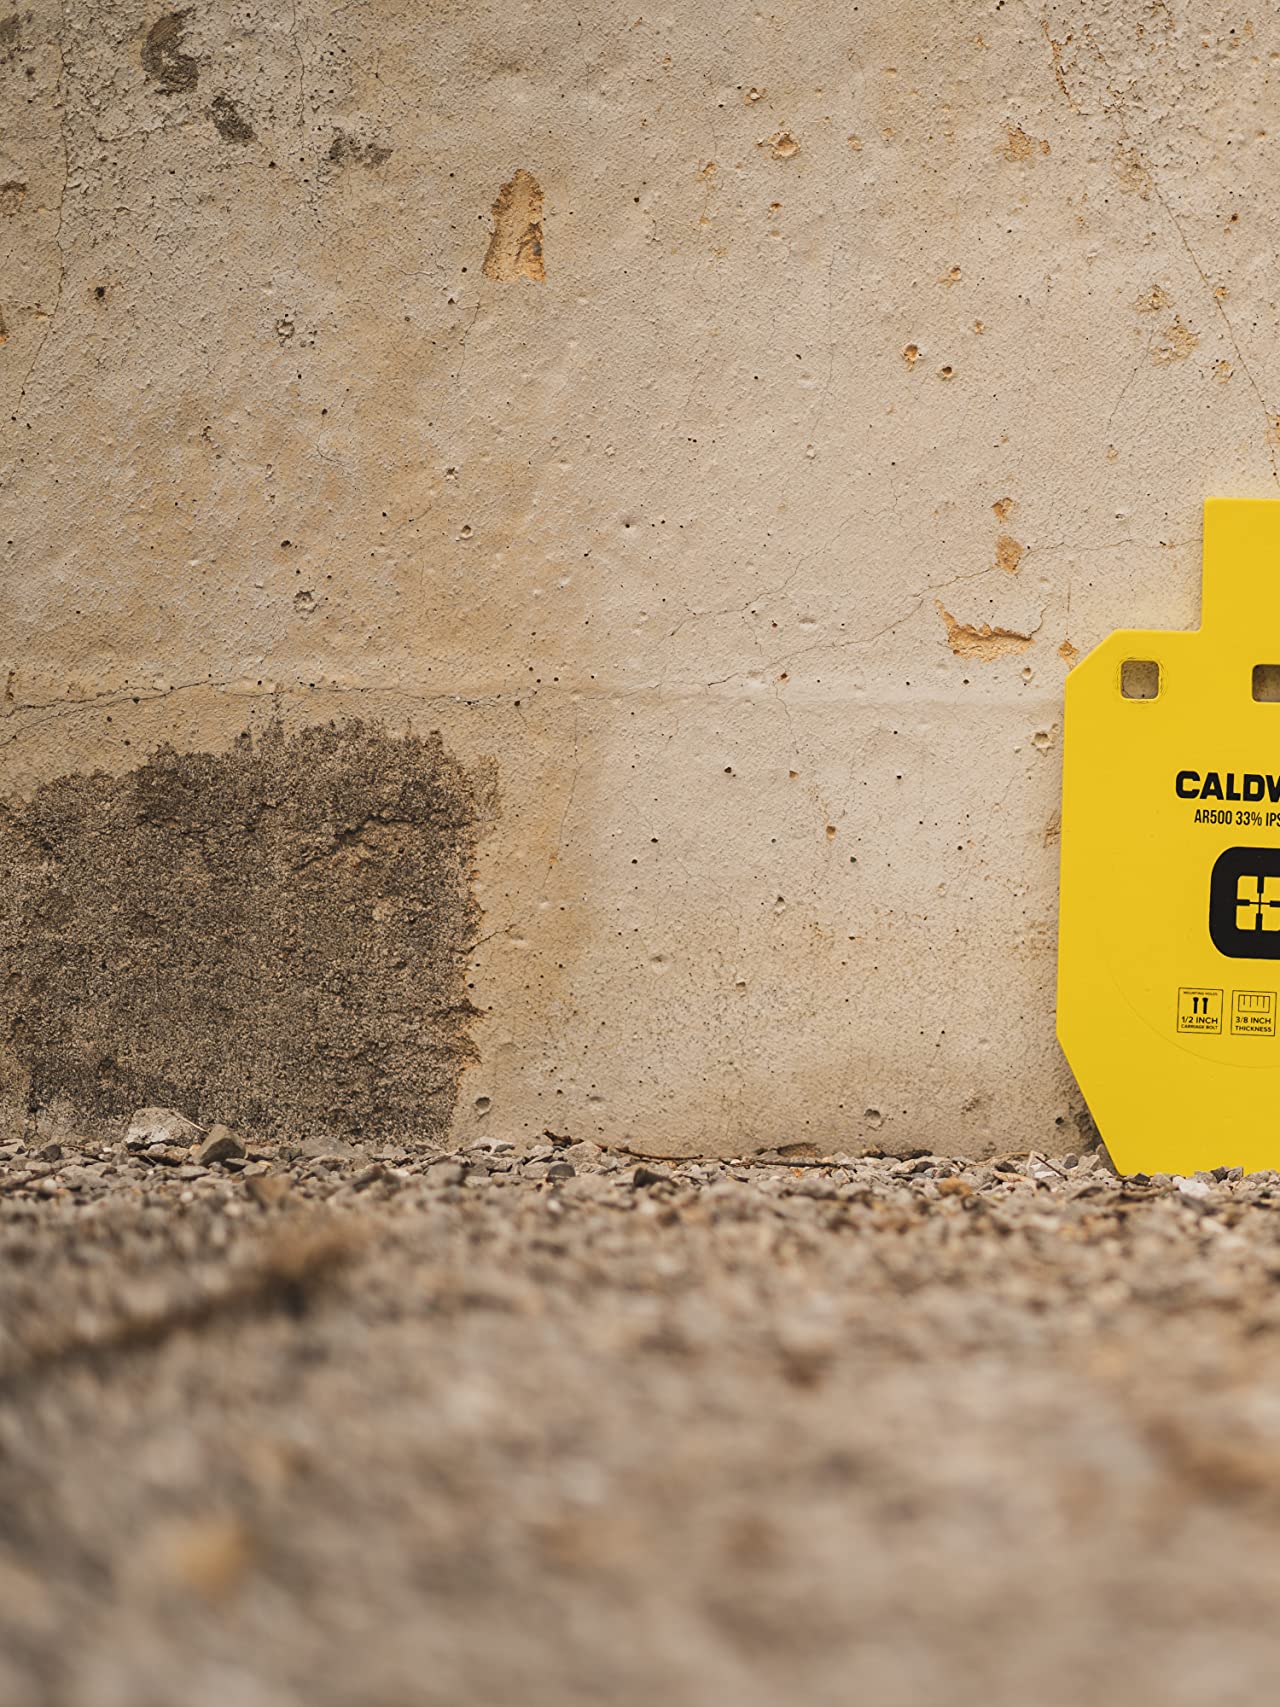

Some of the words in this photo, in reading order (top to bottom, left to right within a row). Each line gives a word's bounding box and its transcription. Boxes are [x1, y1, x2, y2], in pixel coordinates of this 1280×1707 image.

[1194, 809, 1232, 824] AR500
[1236, 811, 1262, 826] 33%
[1235, 1016, 1249, 1024] 3/8
